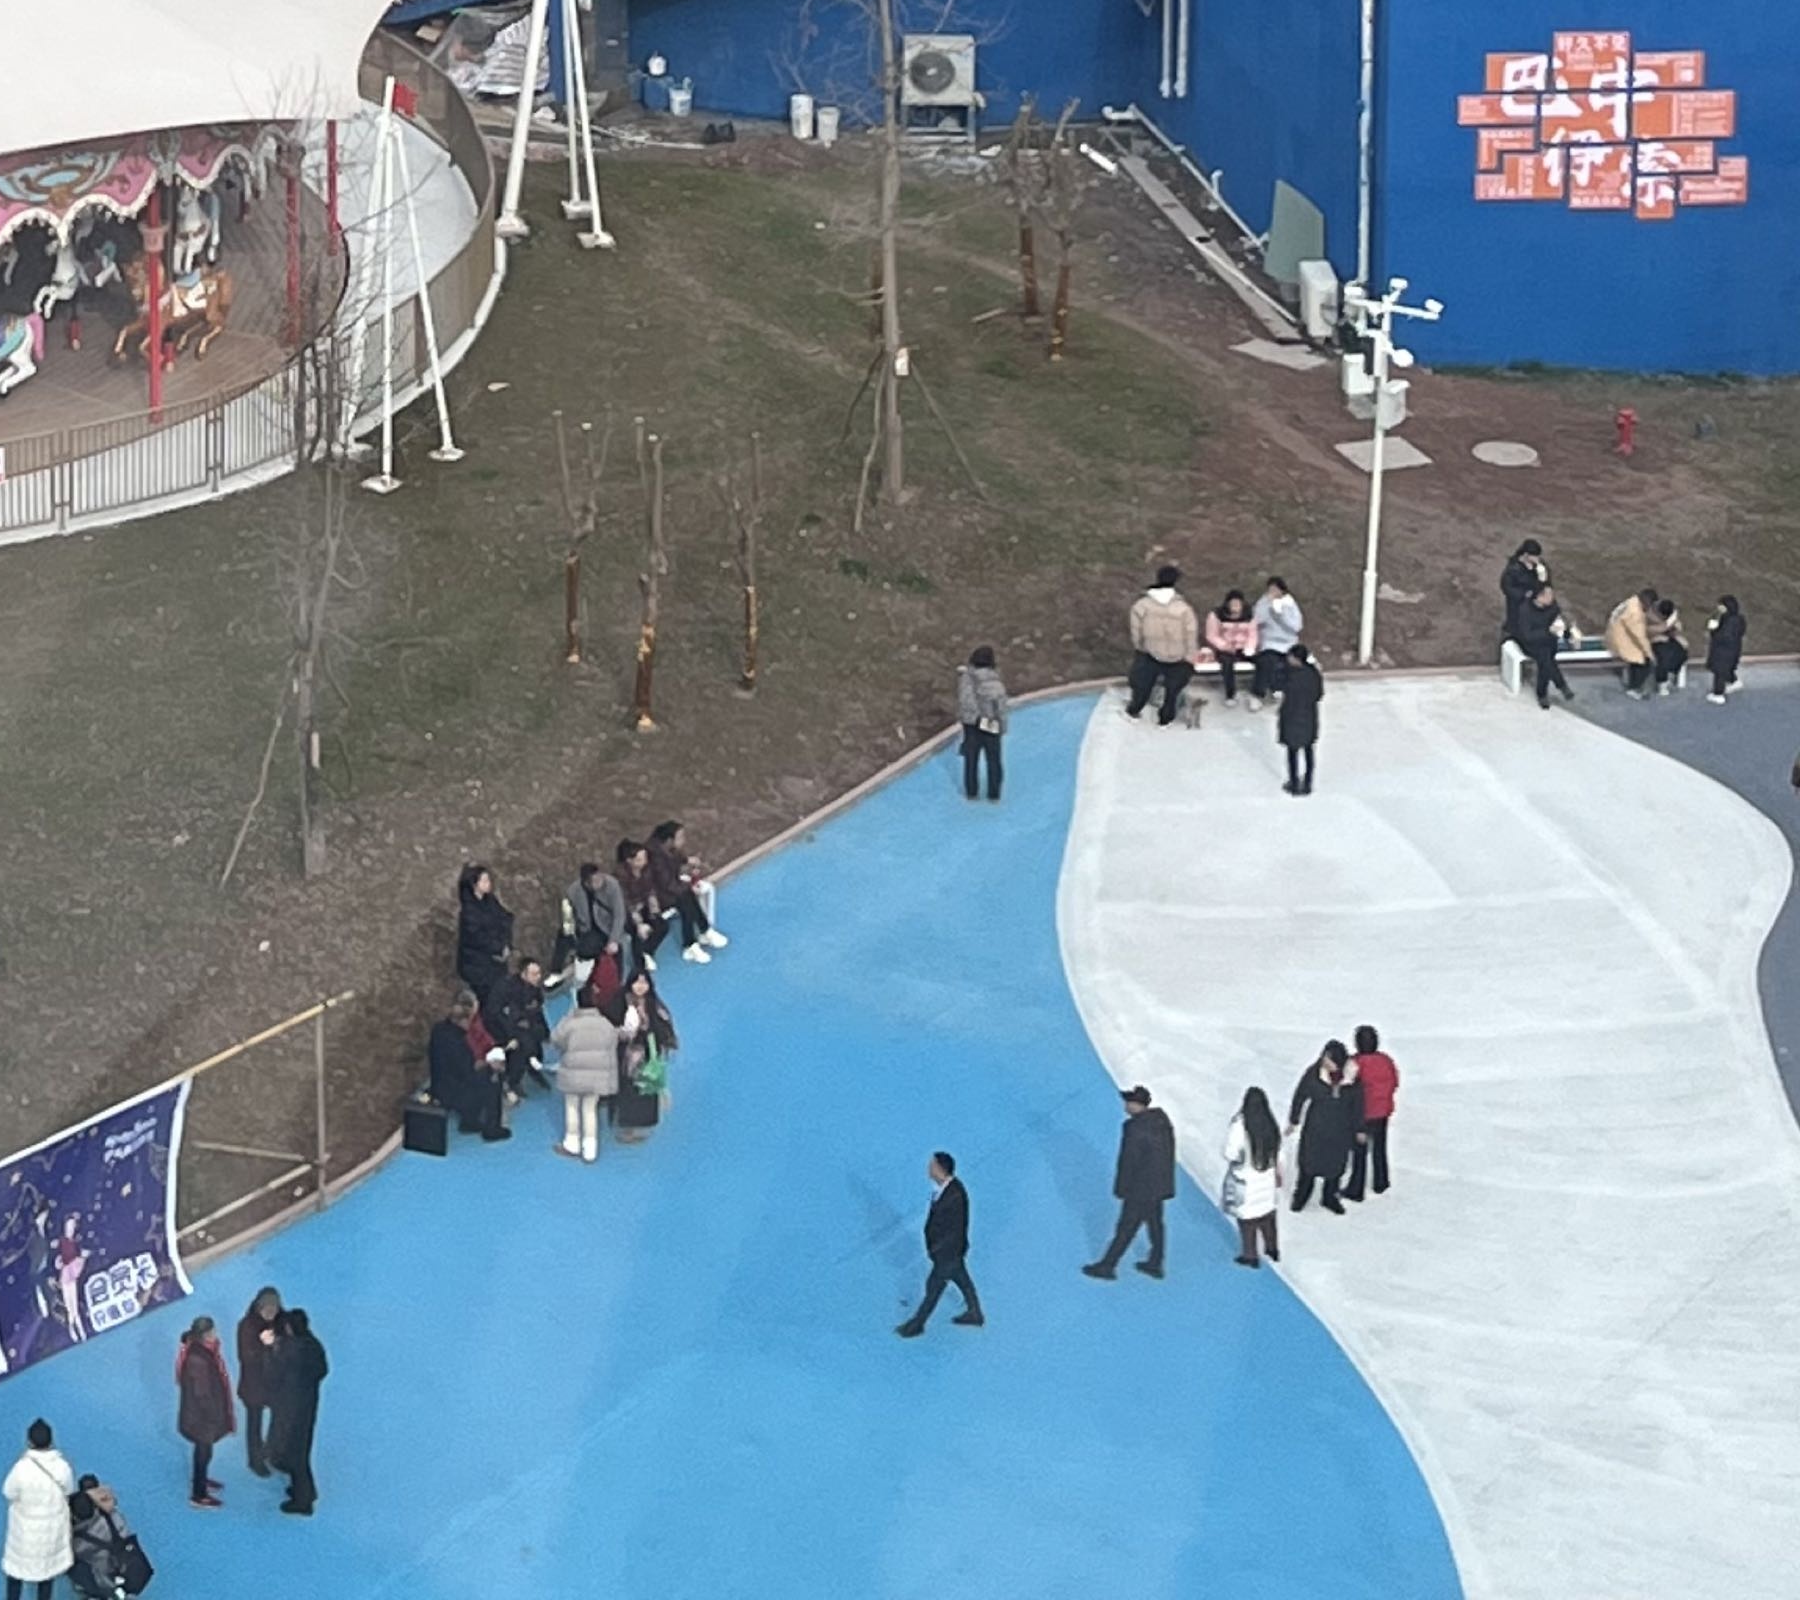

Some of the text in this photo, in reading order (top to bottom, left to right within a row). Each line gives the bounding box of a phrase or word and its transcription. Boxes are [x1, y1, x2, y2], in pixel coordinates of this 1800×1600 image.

[1502, 55, 1657, 139] 巴中
[85, 1253, 158, 1306] 会员卡
